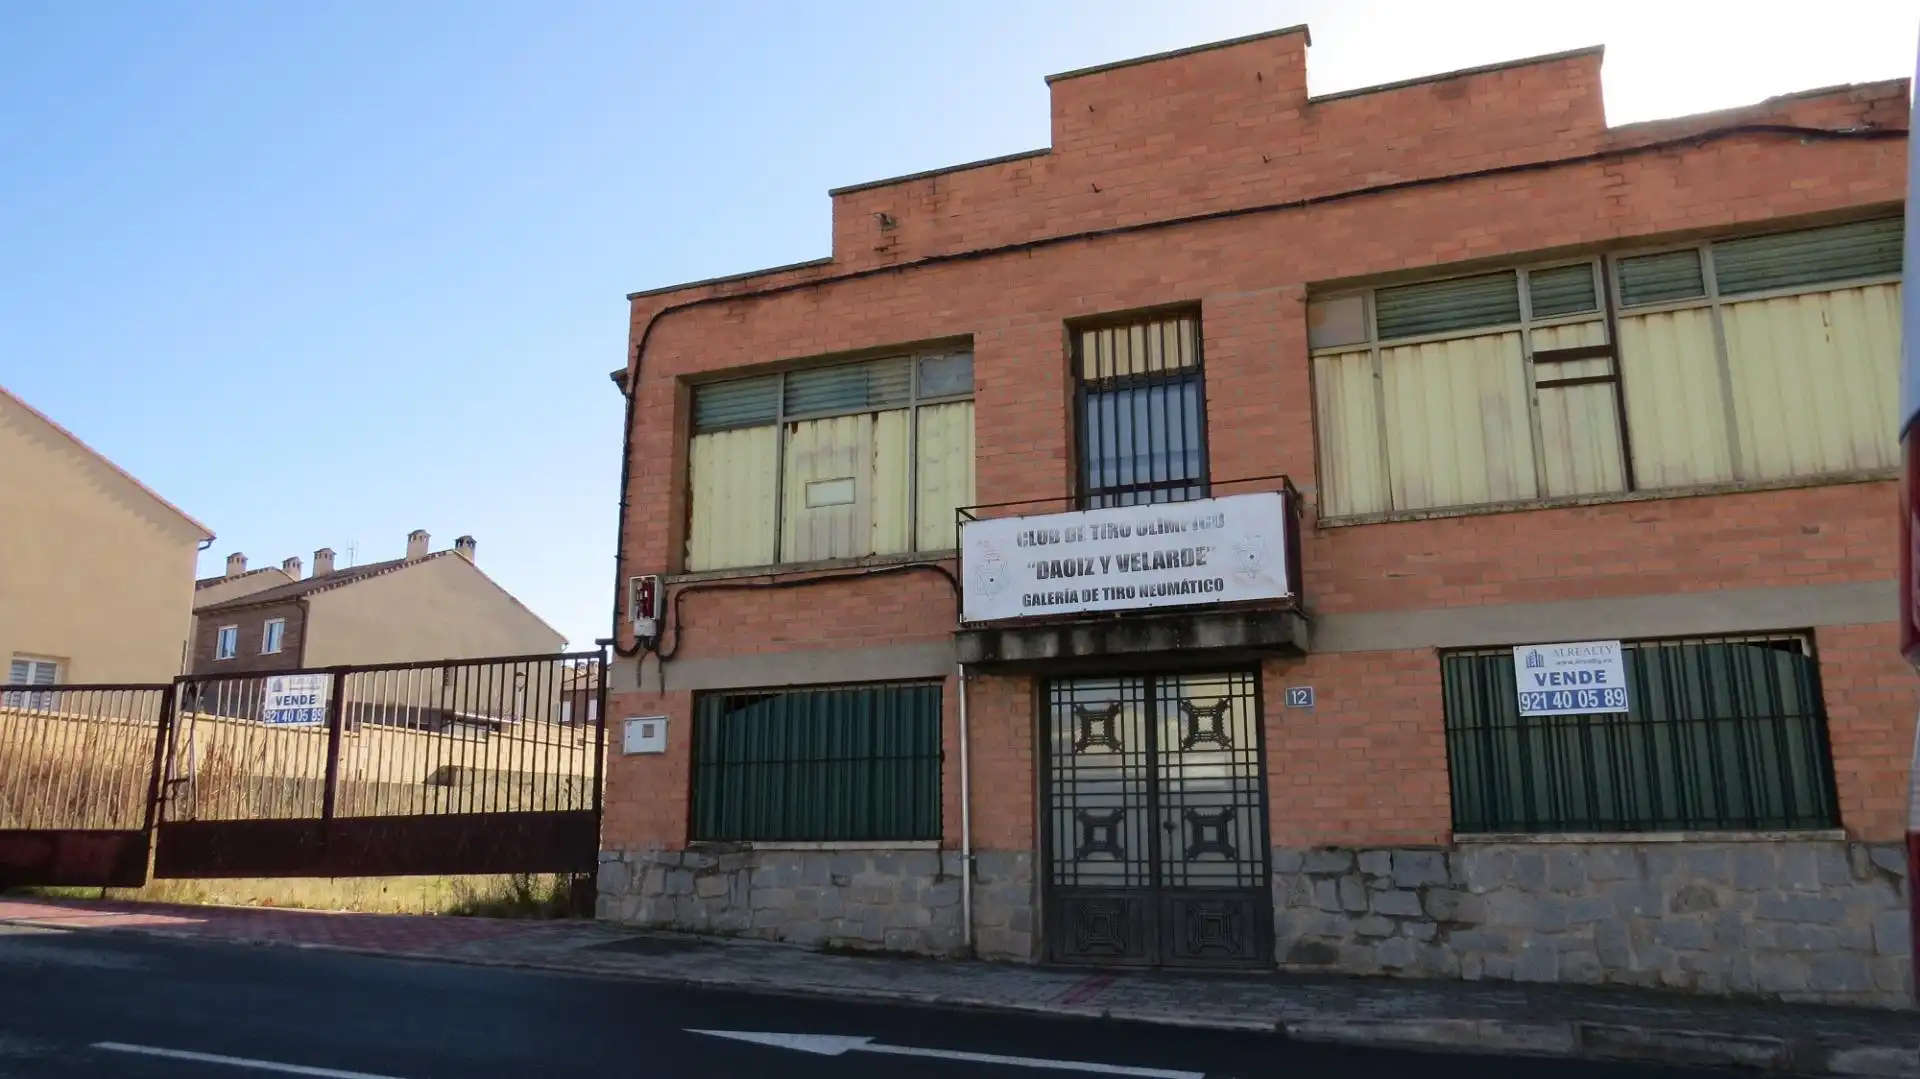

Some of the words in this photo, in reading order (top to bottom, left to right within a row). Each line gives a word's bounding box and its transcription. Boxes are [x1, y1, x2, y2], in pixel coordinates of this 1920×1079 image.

[1017, 528, 1060, 547] CLUB
[1089, 522, 1131, 541] TIRO
[1099, 555, 1113, 575] Y
[1022, 586, 1079, 608] GALERÍA
[1081, 588, 1099, 603] DE
[1101, 586, 1136, 601] TIRO
[1138, 577, 1225, 599] NEUMÁTICO
[1534, 670, 1607, 686] VENDE
[275, 694, 316, 706] VENDE
[1291, 689, 1308, 704] 12
[1521, 692, 1548, 710] 921
[1553, 691, 1572, 709] 40
[1578, 690, 1598, 708] 05
[1604, 688, 1624, 707] 89
[282, 709, 294, 722] 40
[296, 708, 308, 721] 05
